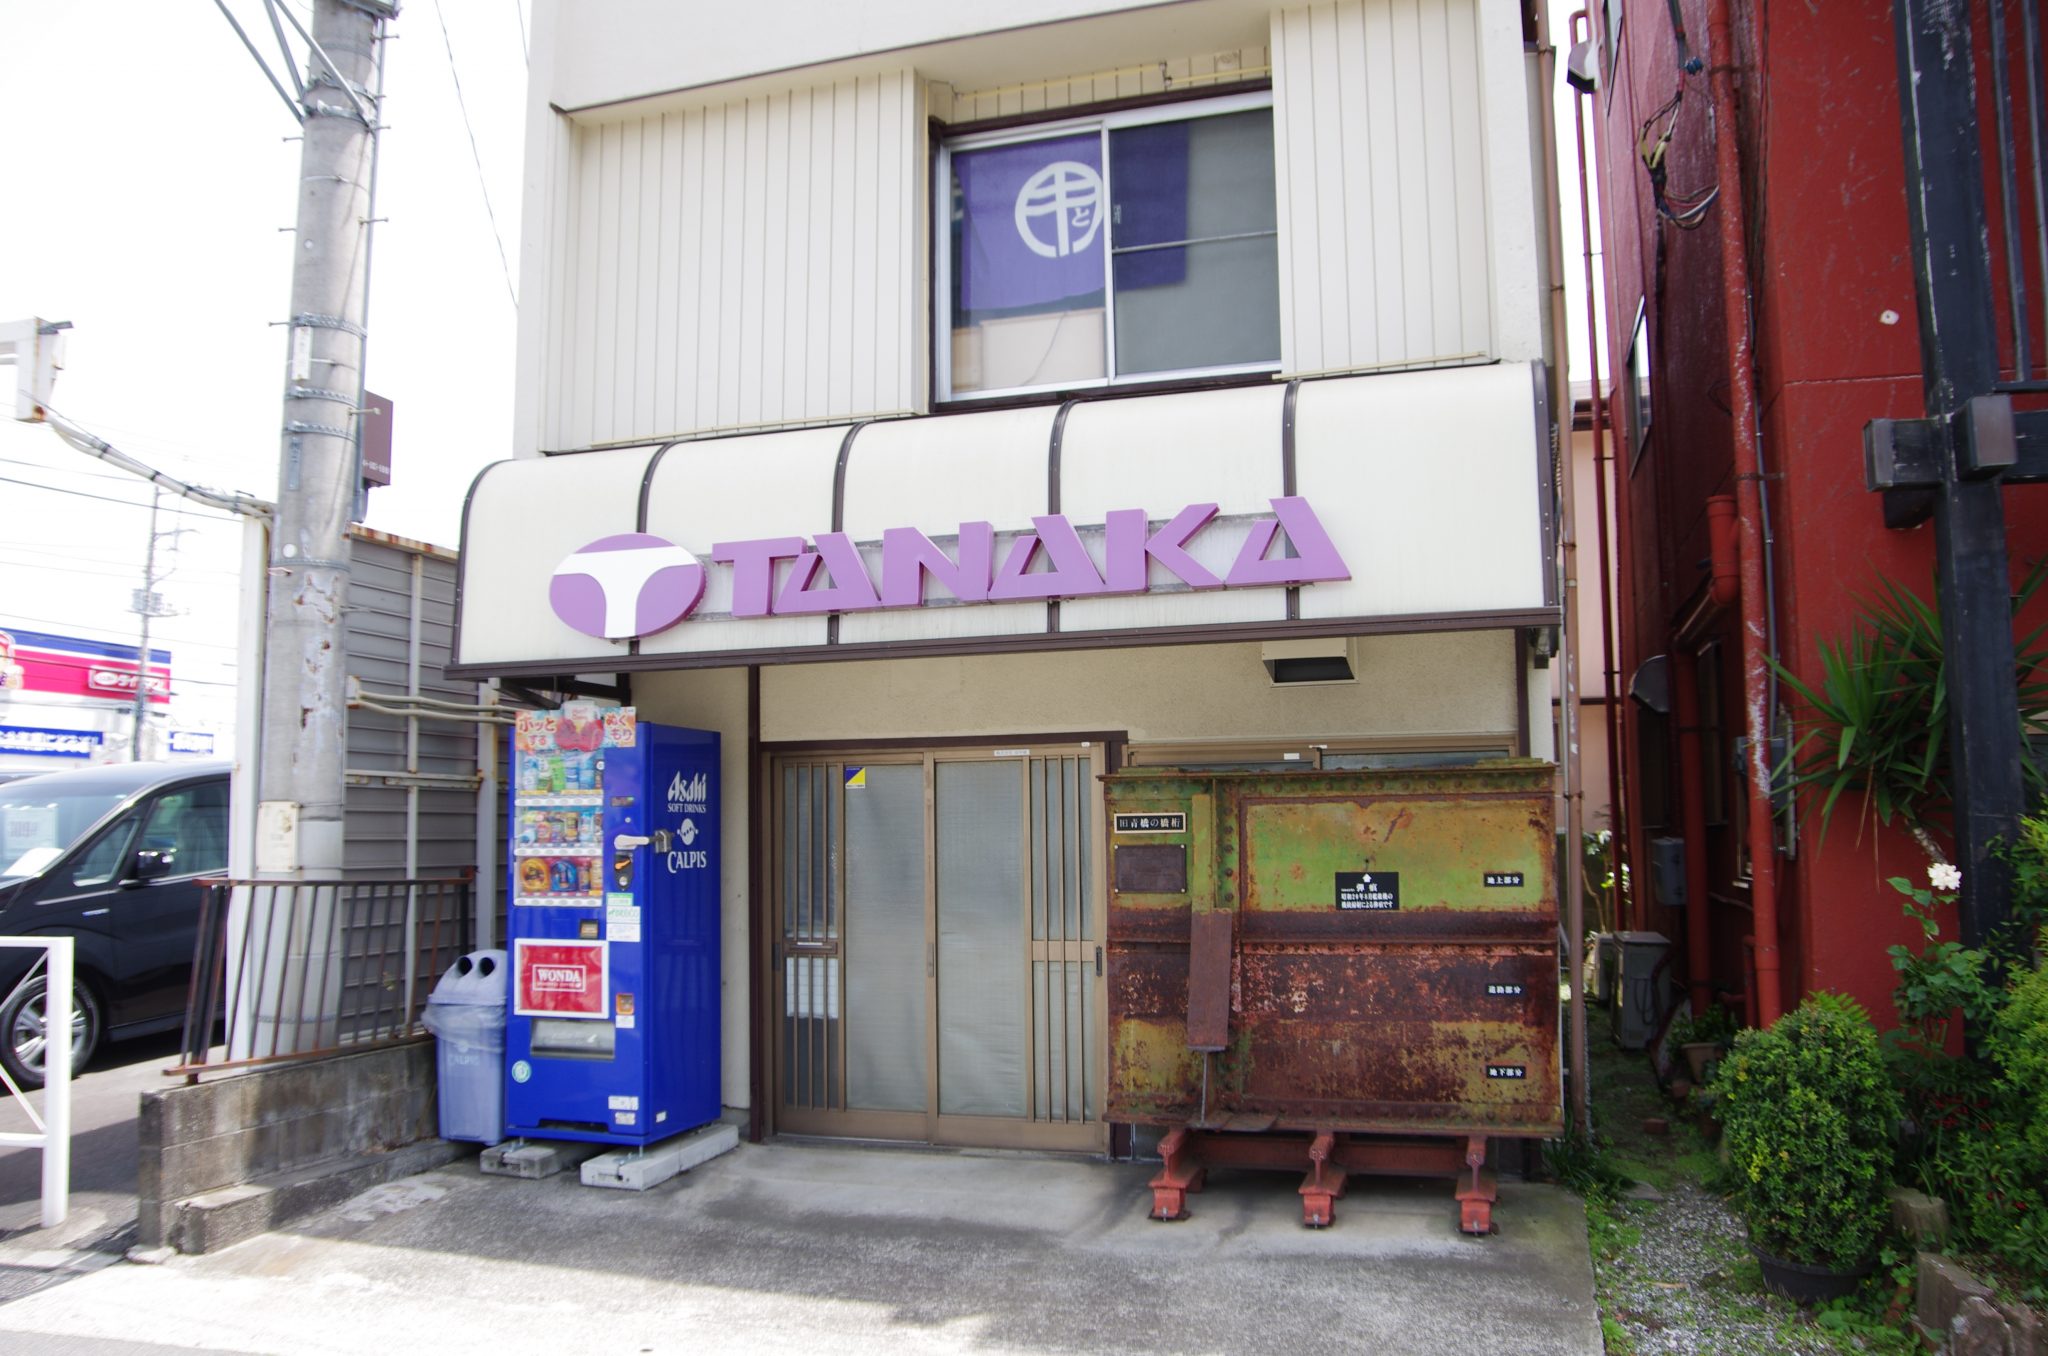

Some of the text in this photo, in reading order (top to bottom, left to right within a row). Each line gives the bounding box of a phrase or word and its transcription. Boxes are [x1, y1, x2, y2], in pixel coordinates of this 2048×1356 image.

[711, 496, 1352, 618] TANAKA
[519, 717, 556, 733] ホッと
[528, 734, 547, 746] する
[610, 727, 633, 741] もり
[667, 770, 707, 802] Asahi
[667, 802, 707, 814] SOFT DRINKS
[667, 850, 707, 874] CALPIS
[1487, 875, 1520, 885] 地上部分
[537, 968, 582, 983] WONDA
[1489, 1067, 1523, 1077] 地下部分
